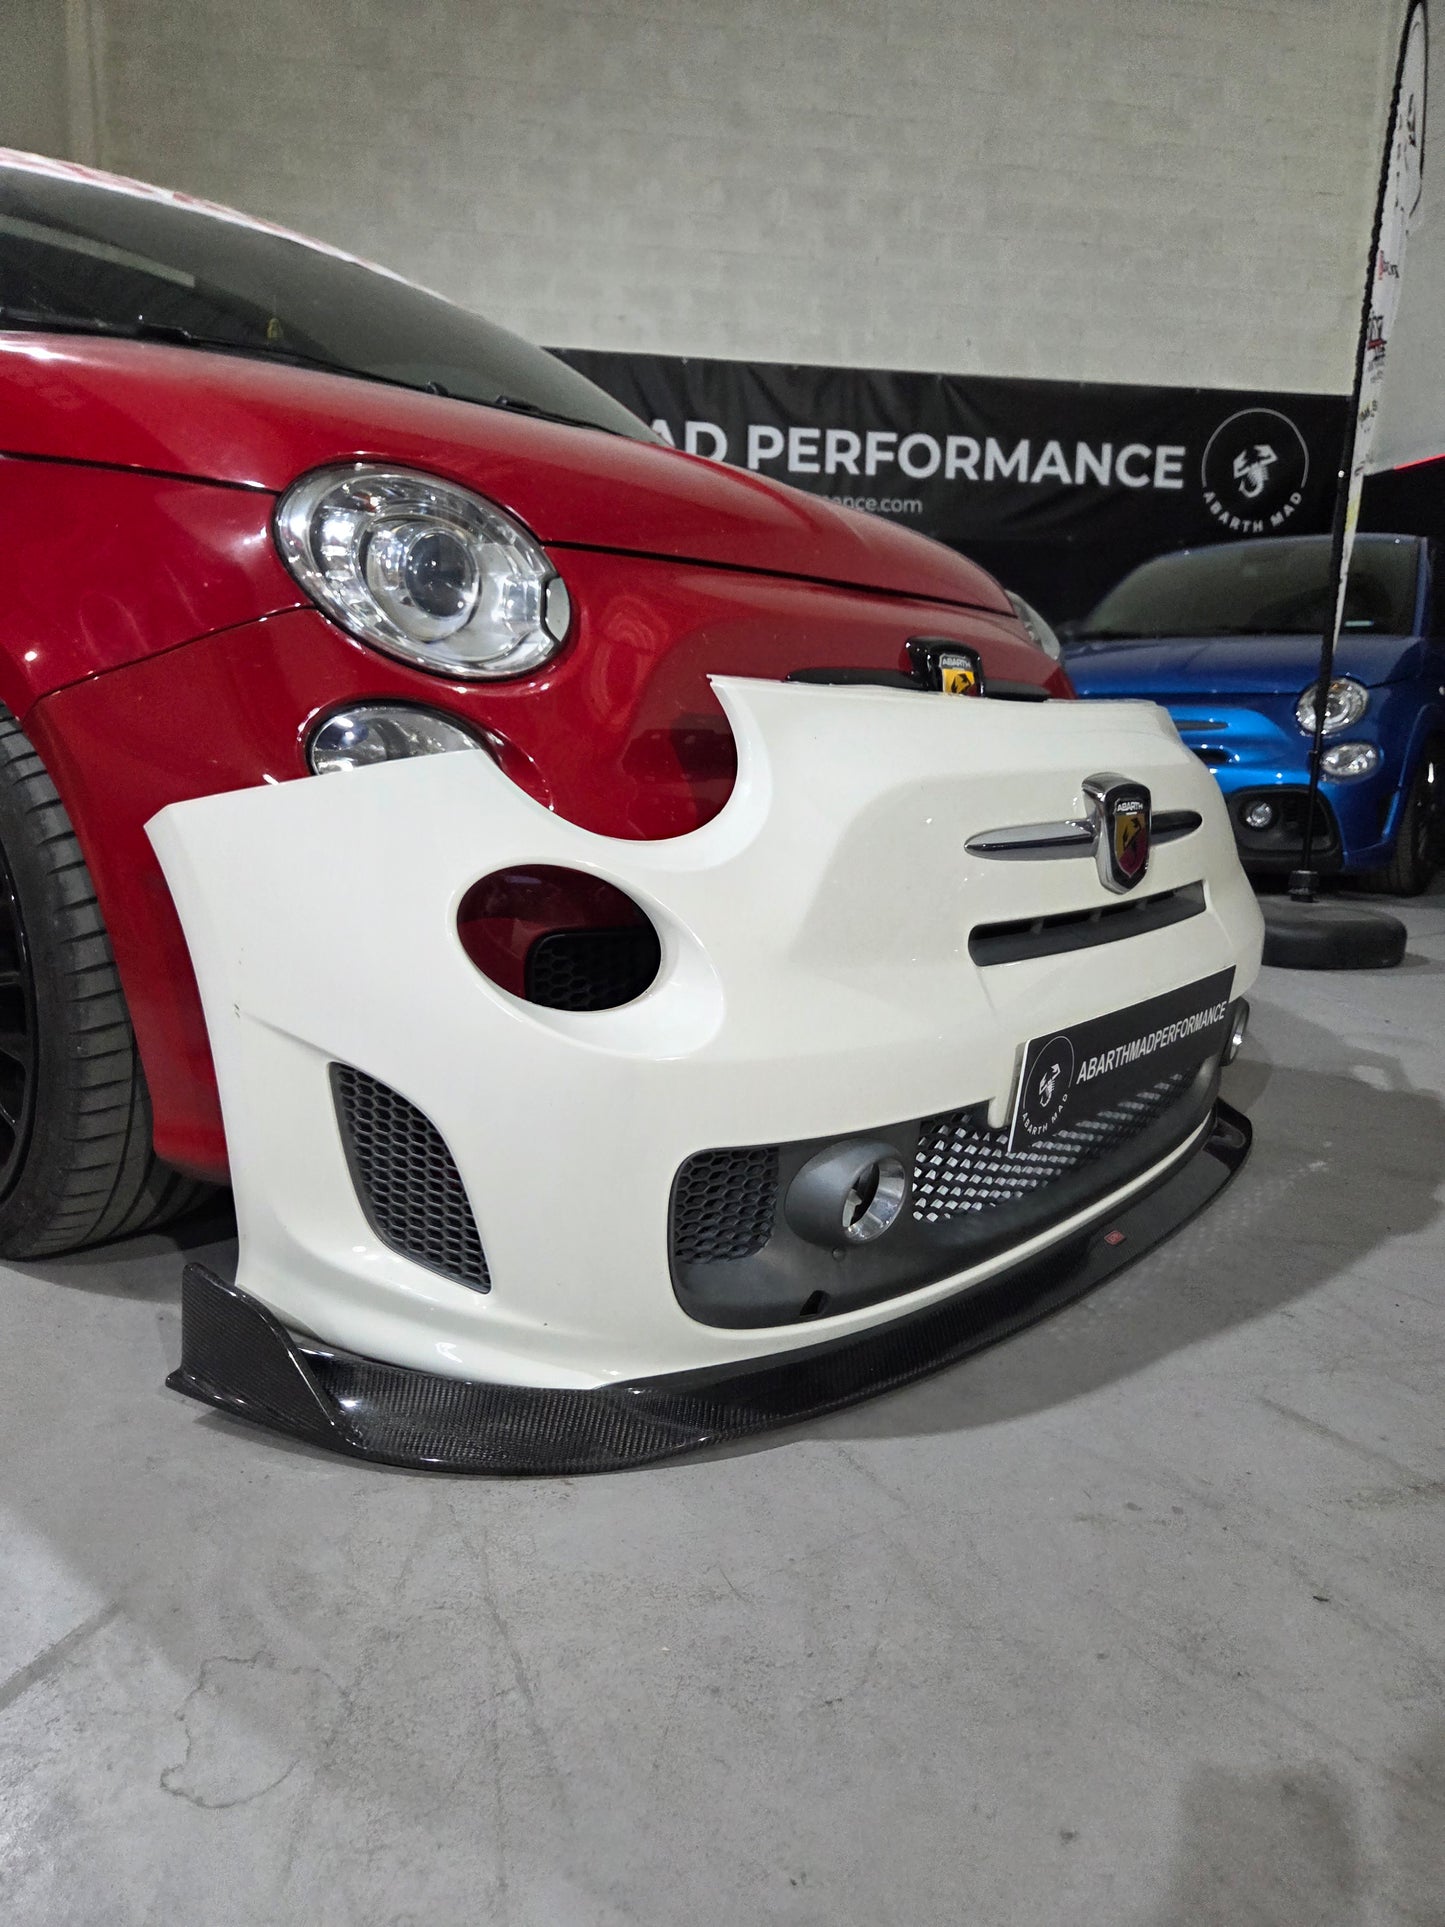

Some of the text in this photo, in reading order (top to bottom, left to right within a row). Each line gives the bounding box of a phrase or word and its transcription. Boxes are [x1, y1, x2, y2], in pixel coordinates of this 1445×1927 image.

[746, 423, 1187, 489] PERFORMANCE
[1203, 491, 1303, 533] ABARTH MAD
[942, 656, 972, 668] ABARTH
[1116, 800, 1144, 812] ABARTH
[1075, 1000, 1228, 1085] ABARTHMADPERFORMANCE
[1022, 1093, 1069, 1136] ABARTH MAD
